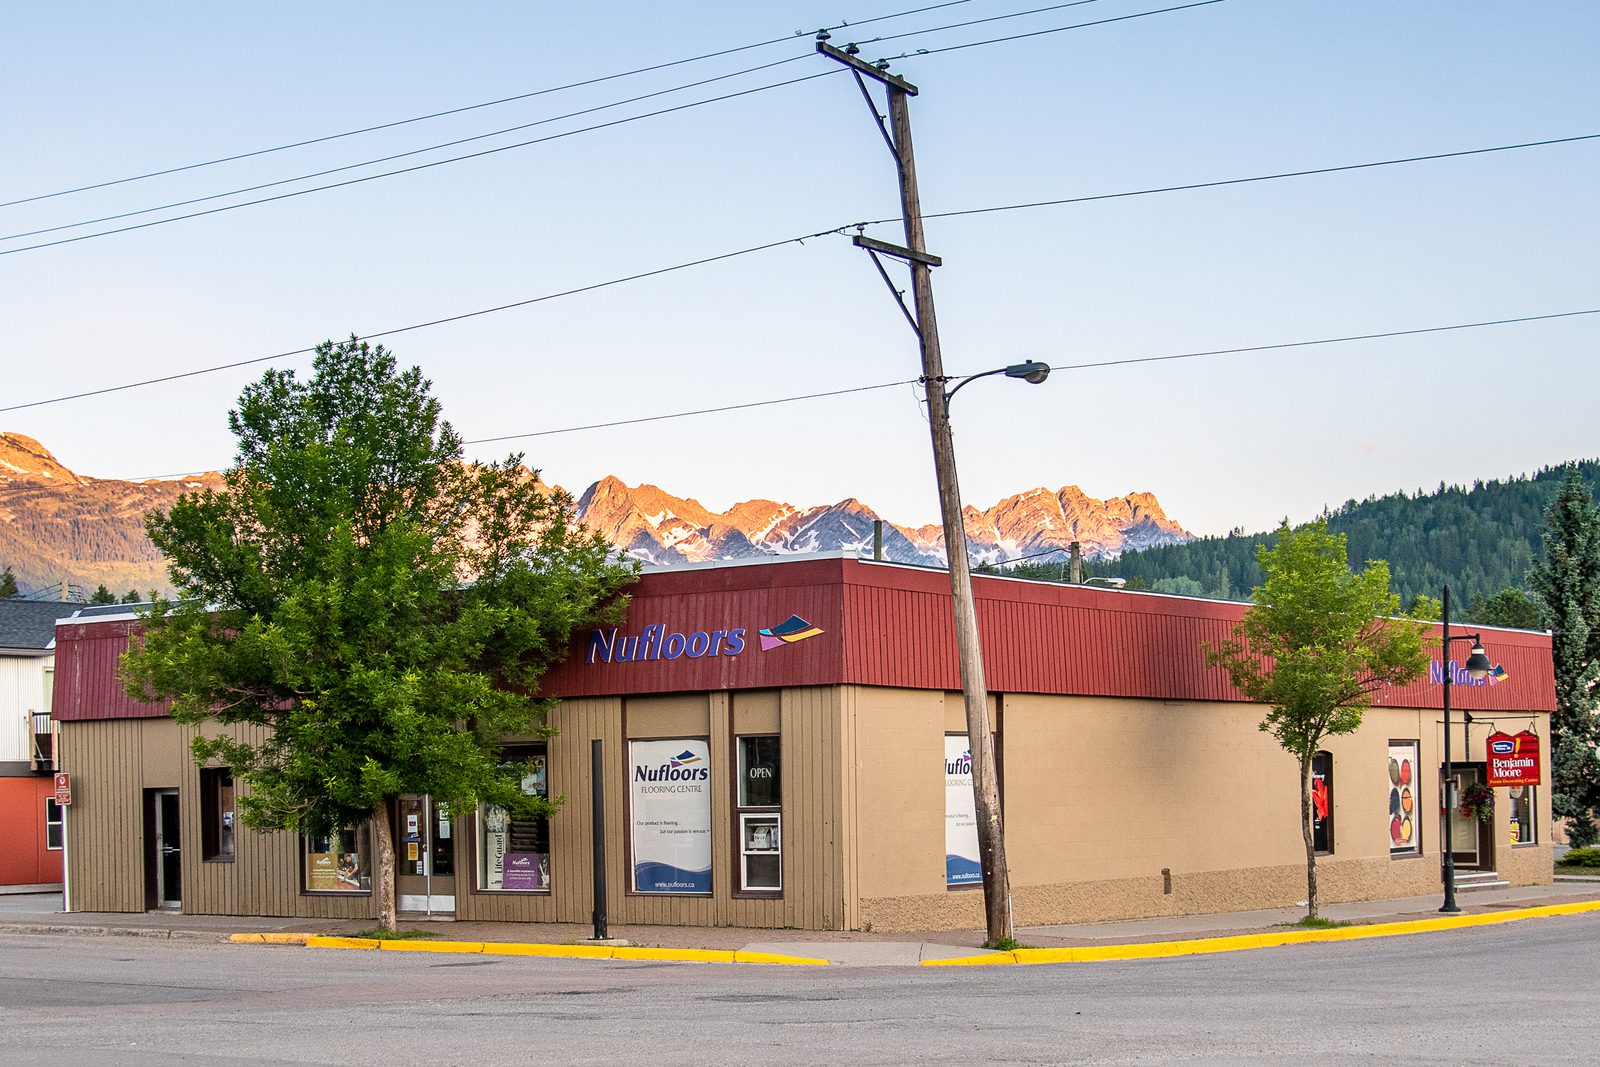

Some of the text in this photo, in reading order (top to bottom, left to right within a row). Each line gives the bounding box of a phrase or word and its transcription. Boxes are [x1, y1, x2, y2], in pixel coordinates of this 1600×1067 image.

[585, 624, 746, 663] Nufloors
[1492, 757, 1534, 769] Benjamin
[635, 764, 708, 782] Nufloors
[749, 767, 772, 779] OPEN
[1493, 767, 1522, 778] Moore
[641, 784, 702, 794] FLOORING CENTRE
[494, 833, 503, 874] LifeGuard
